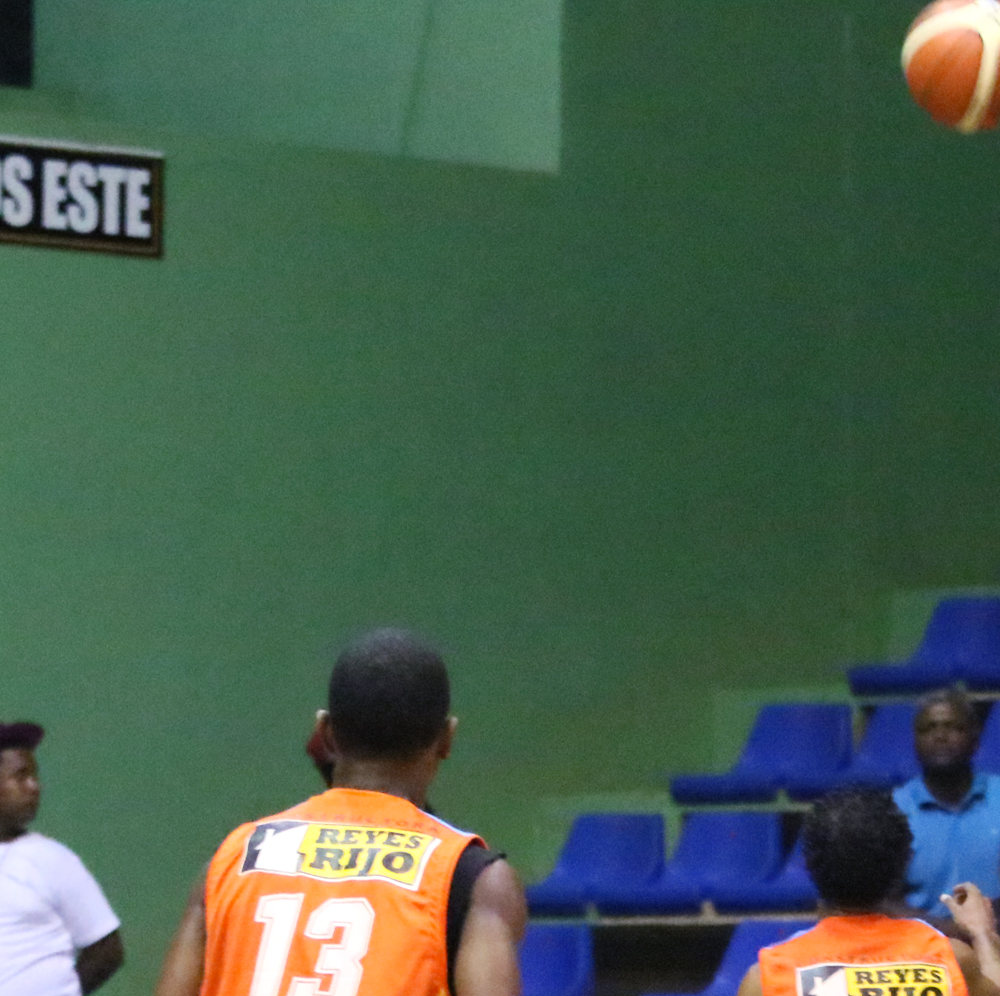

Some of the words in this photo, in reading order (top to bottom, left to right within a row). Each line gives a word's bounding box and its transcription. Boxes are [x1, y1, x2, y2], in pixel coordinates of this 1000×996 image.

[0, 154, 34, 227] S
[41, 159, 151, 239] ESTE
[316, 828, 424, 850] REYES
[309, 848, 414, 876] RIJO
[855, 968, 943, 985] REYES
